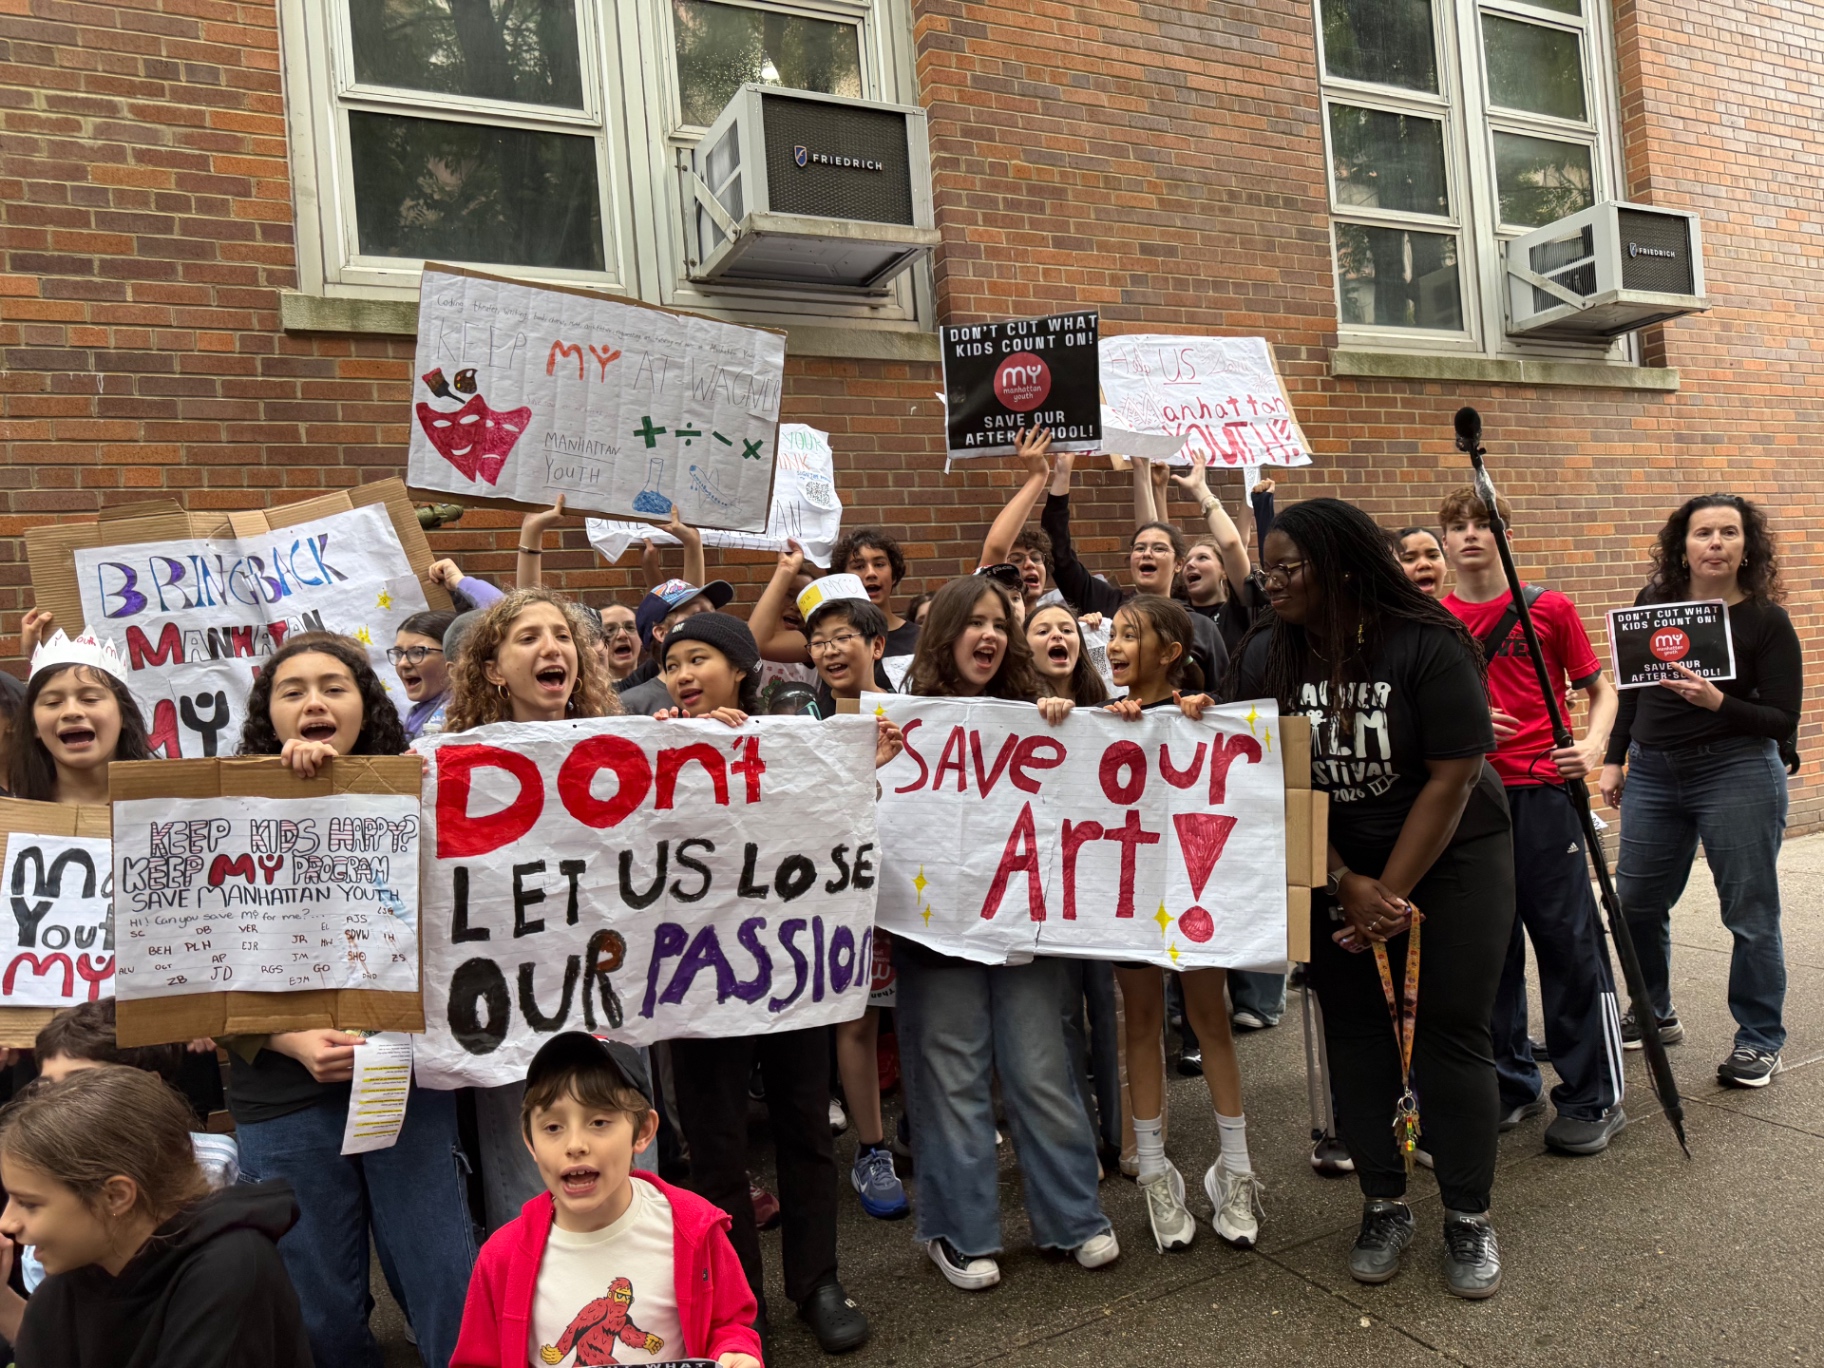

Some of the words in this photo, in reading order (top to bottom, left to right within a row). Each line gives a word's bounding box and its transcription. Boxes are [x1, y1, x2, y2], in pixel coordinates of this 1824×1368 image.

[812, 153, 883, 170] FRIEDRICH
[1638, 247, 1676, 258] FRIEDRICH
[950, 324, 998, 343] DON'T
[1006, 319, 1039, 336] CUT
[1048, 314, 1098, 333] WHAT
[955, 340, 994, 358] KIDS
[1002, 335, 1056, 354] COUNT
[1065, 331, 1095, 347] ON!
[437, 317, 527, 370] KEEP
[546, 339, 622, 384] MY
[632, 350, 680, 394] AT
[690, 357, 781, 413] WAGNER
[1158, 347, 1196, 382] US
[1003, 384, 1042, 395] manhattan
[1013, 393, 1034, 402] youth
[984, 413, 1026, 428] SAVE
[1034, 410, 1066, 425] OUR
[545, 432, 622, 456] MANHATTAN
[545, 458, 601, 485] YOUTH
[1617, 611, 1652, 623] DON'T
[1657, 608, 1680, 618] CUT
[1684, 605, 1719, 616] WHAT
[1622, 620, 1649, 631] KIDS
[1653, 617, 1691, 628] COUNT
[1697, 614, 1717, 624] ON!
[1644, 662, 1672, 672] SAVE
[1679, 660, 1701, 668] OUR
[1099, 732, 1263, 805] our
[150, 818, 231, 858] KEEP
[250, 817, 321, 855] KIDS
[328, 814, 420, 852] HAPPY?
[123, 853, 205, 893] KEEP
[208, 853, 284, 887] MY
[292, 854, 390, 885] PROGRAM
[980, 800, 1238, 943] Art!
[131, 888, 191, 913] SAVE
[198, 885, 331, 909] MANHATTAN
[336, 885, 400, 903] YOUTH
[451, 859, 586, 944] LET
[618, 837, 717, 909] US
[737, 842, 875, 902] LOSE
[203, 911, 235, 921] save
[262, 912, 277, 921] for
[148, 945, 172, 956] BEH
[447, 929, 627, 1055] OUR
